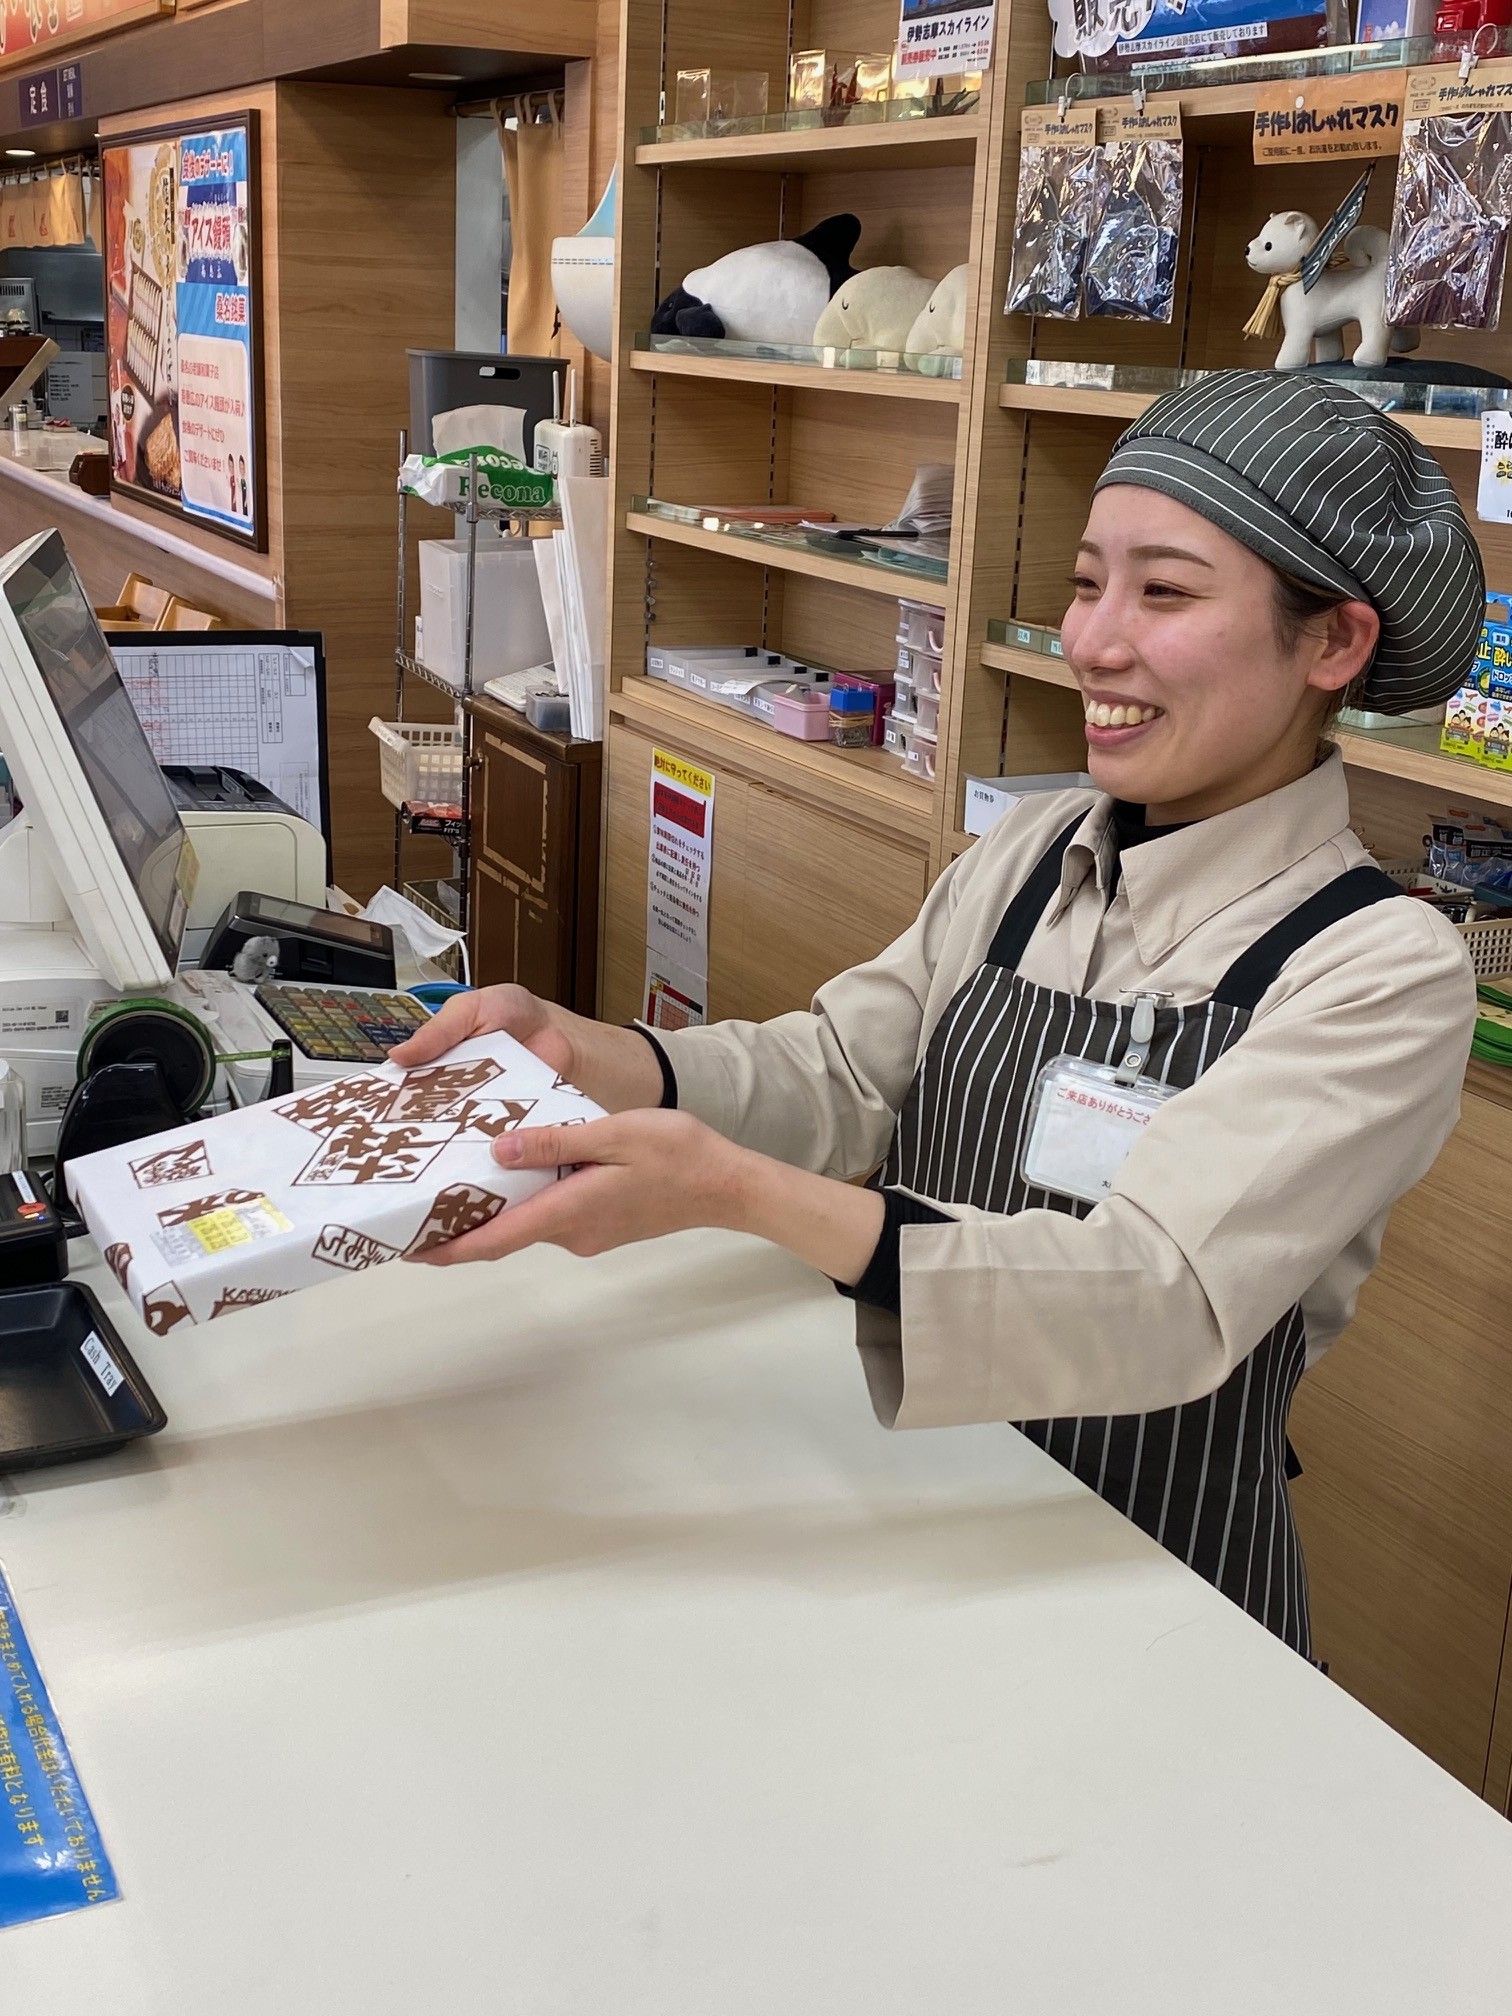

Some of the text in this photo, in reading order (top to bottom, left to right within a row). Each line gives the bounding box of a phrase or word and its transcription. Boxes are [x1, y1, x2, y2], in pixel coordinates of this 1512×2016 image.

[907, 15, 990, 43] 伊勢志摩スカイライン
[1073, 0, 1153, 41] 販売
[29, 80, 48, 114] 定食
[1256, 102, 1399, 137] 手作りおしゃれマスク
[1494, 430, 1512, 450] 酔
[654, 754, 711, 791] 絶対に守ってください
[84, 1337, 117, 1390] Cash Tray
